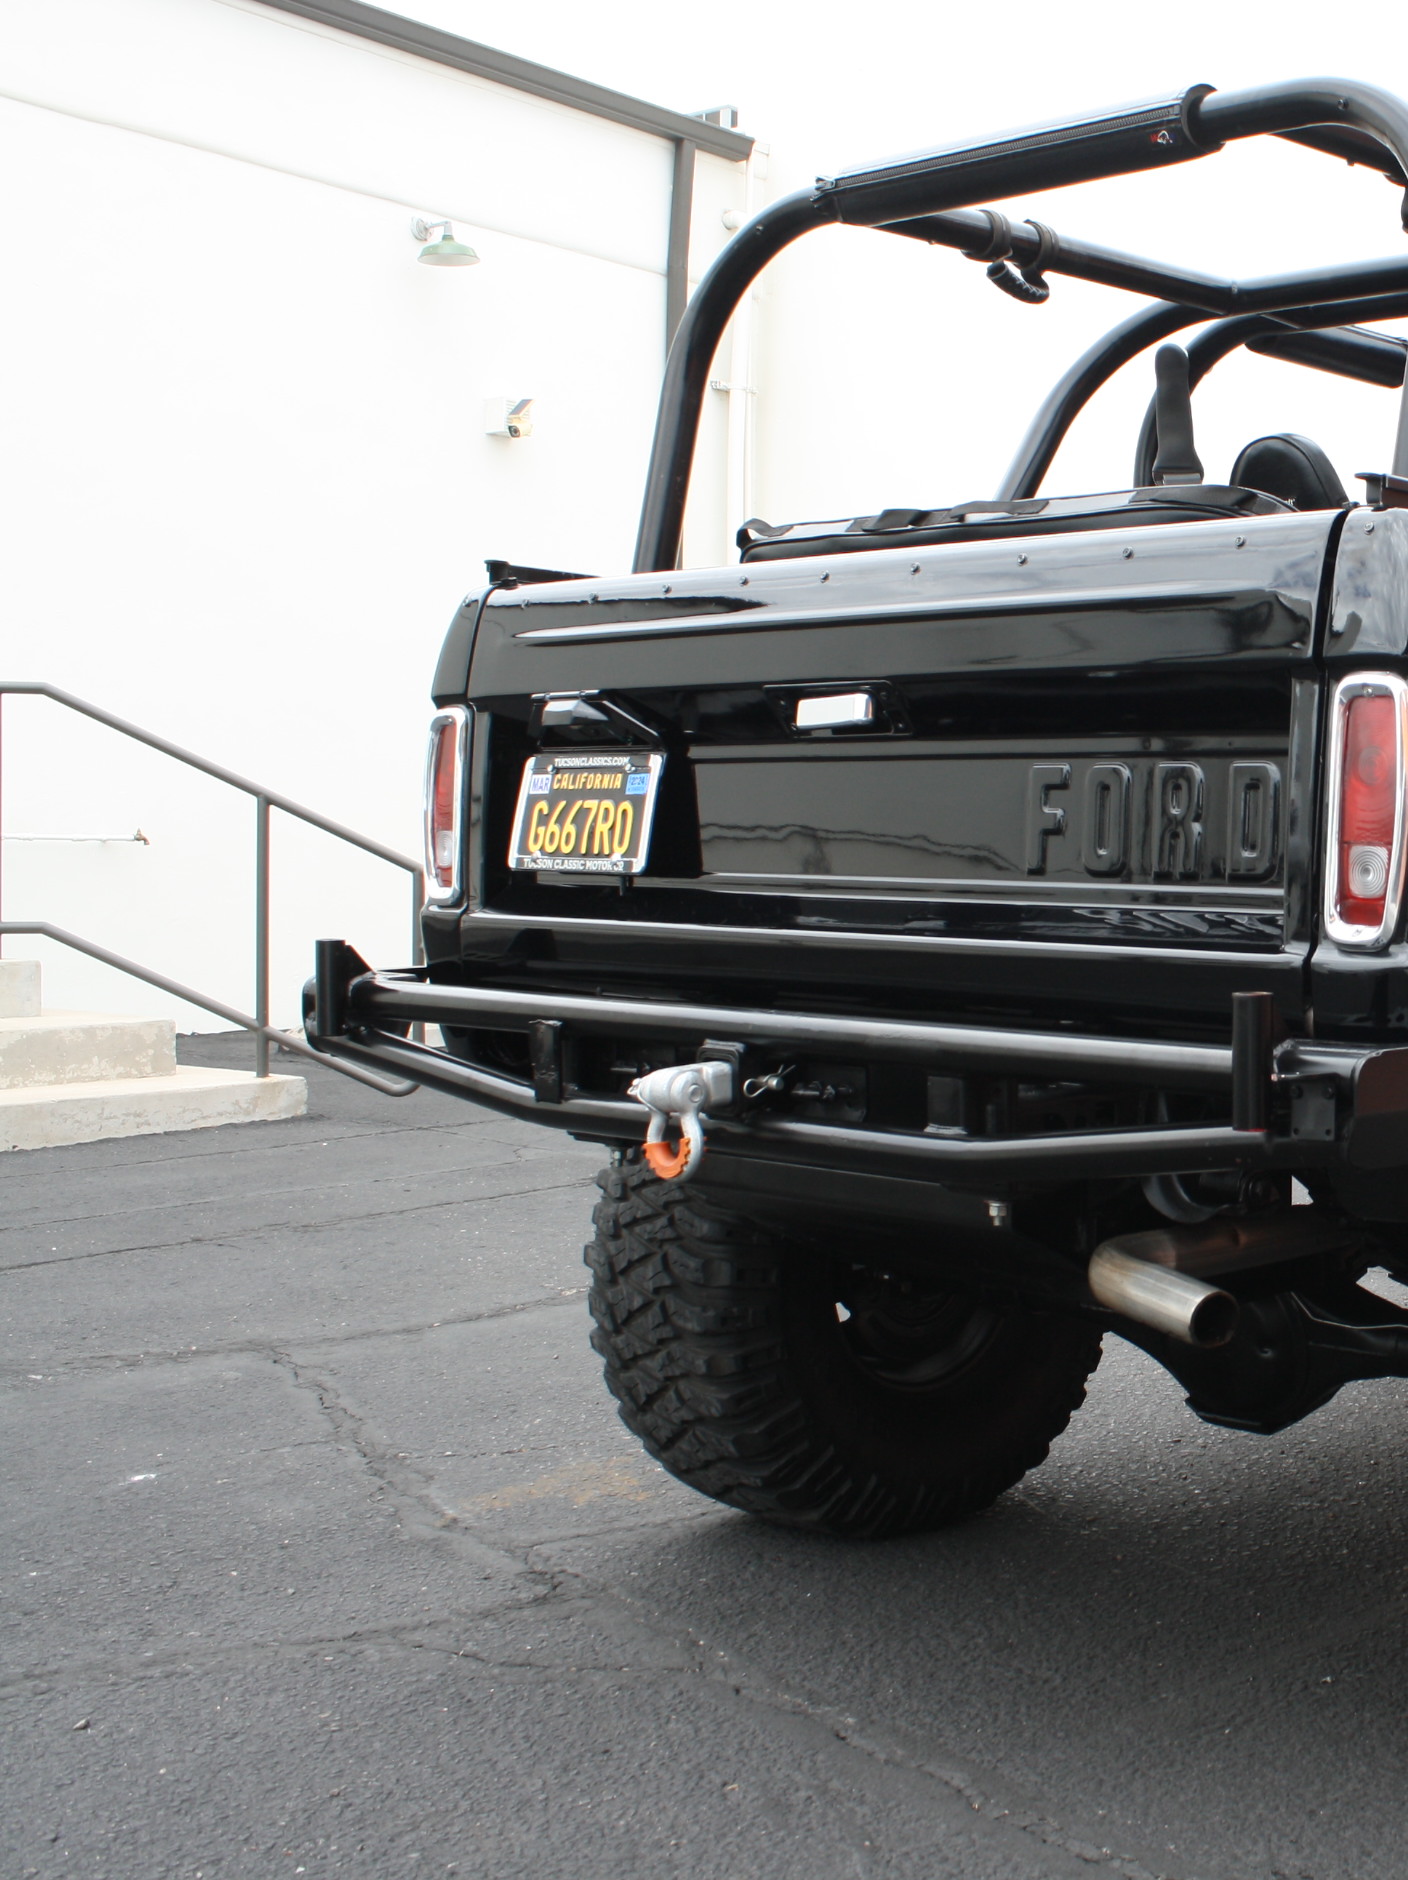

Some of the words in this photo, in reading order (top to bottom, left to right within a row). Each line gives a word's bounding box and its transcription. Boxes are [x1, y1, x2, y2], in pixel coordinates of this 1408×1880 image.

[554, 756, 631, 767] TUCSONCLASSICS.COM
[532, 776, 550, 792] MAR
[553, 773, 624, 790] CALIFORNIA
[1026, 760, 1282, 883] FORD
[523, 858, 553, 869] TUCSON
[554, 859, 585, 870] CLASSIC
[585, 860, 612, 871] MOTOR
